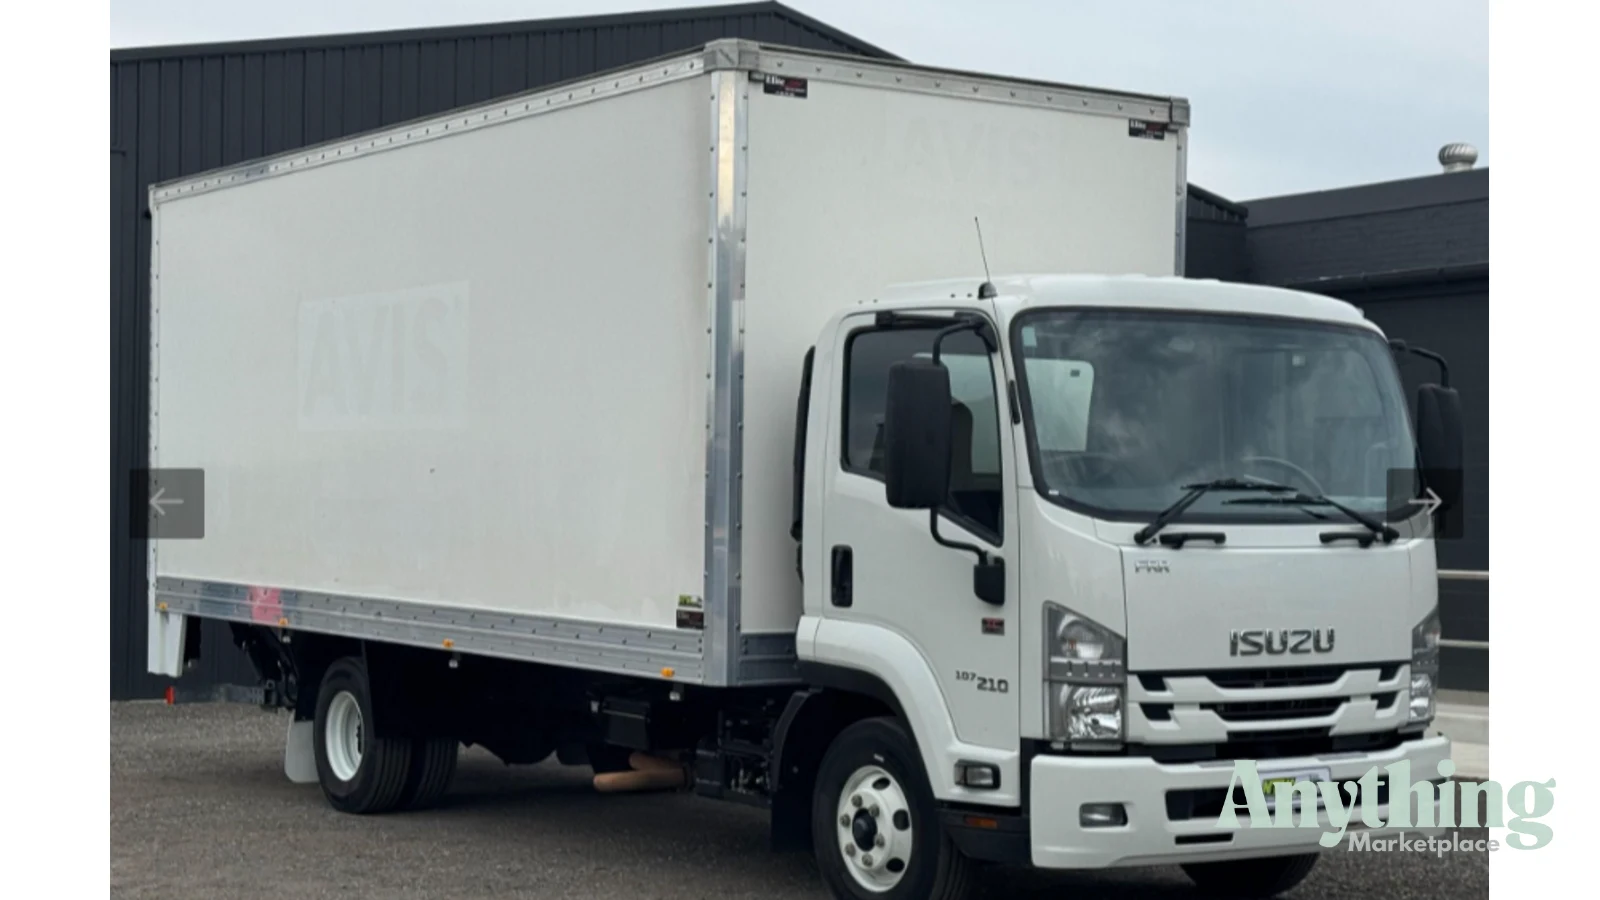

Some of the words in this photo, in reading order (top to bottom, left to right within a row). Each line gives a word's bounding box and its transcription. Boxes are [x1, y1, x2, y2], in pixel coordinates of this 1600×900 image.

[302, 296, 449, 416] AVIS
[1229, 627, 1335, 657] ISUZU
[956, 669, 977, 681] 107
[977, 676, 1009, 694] 210
